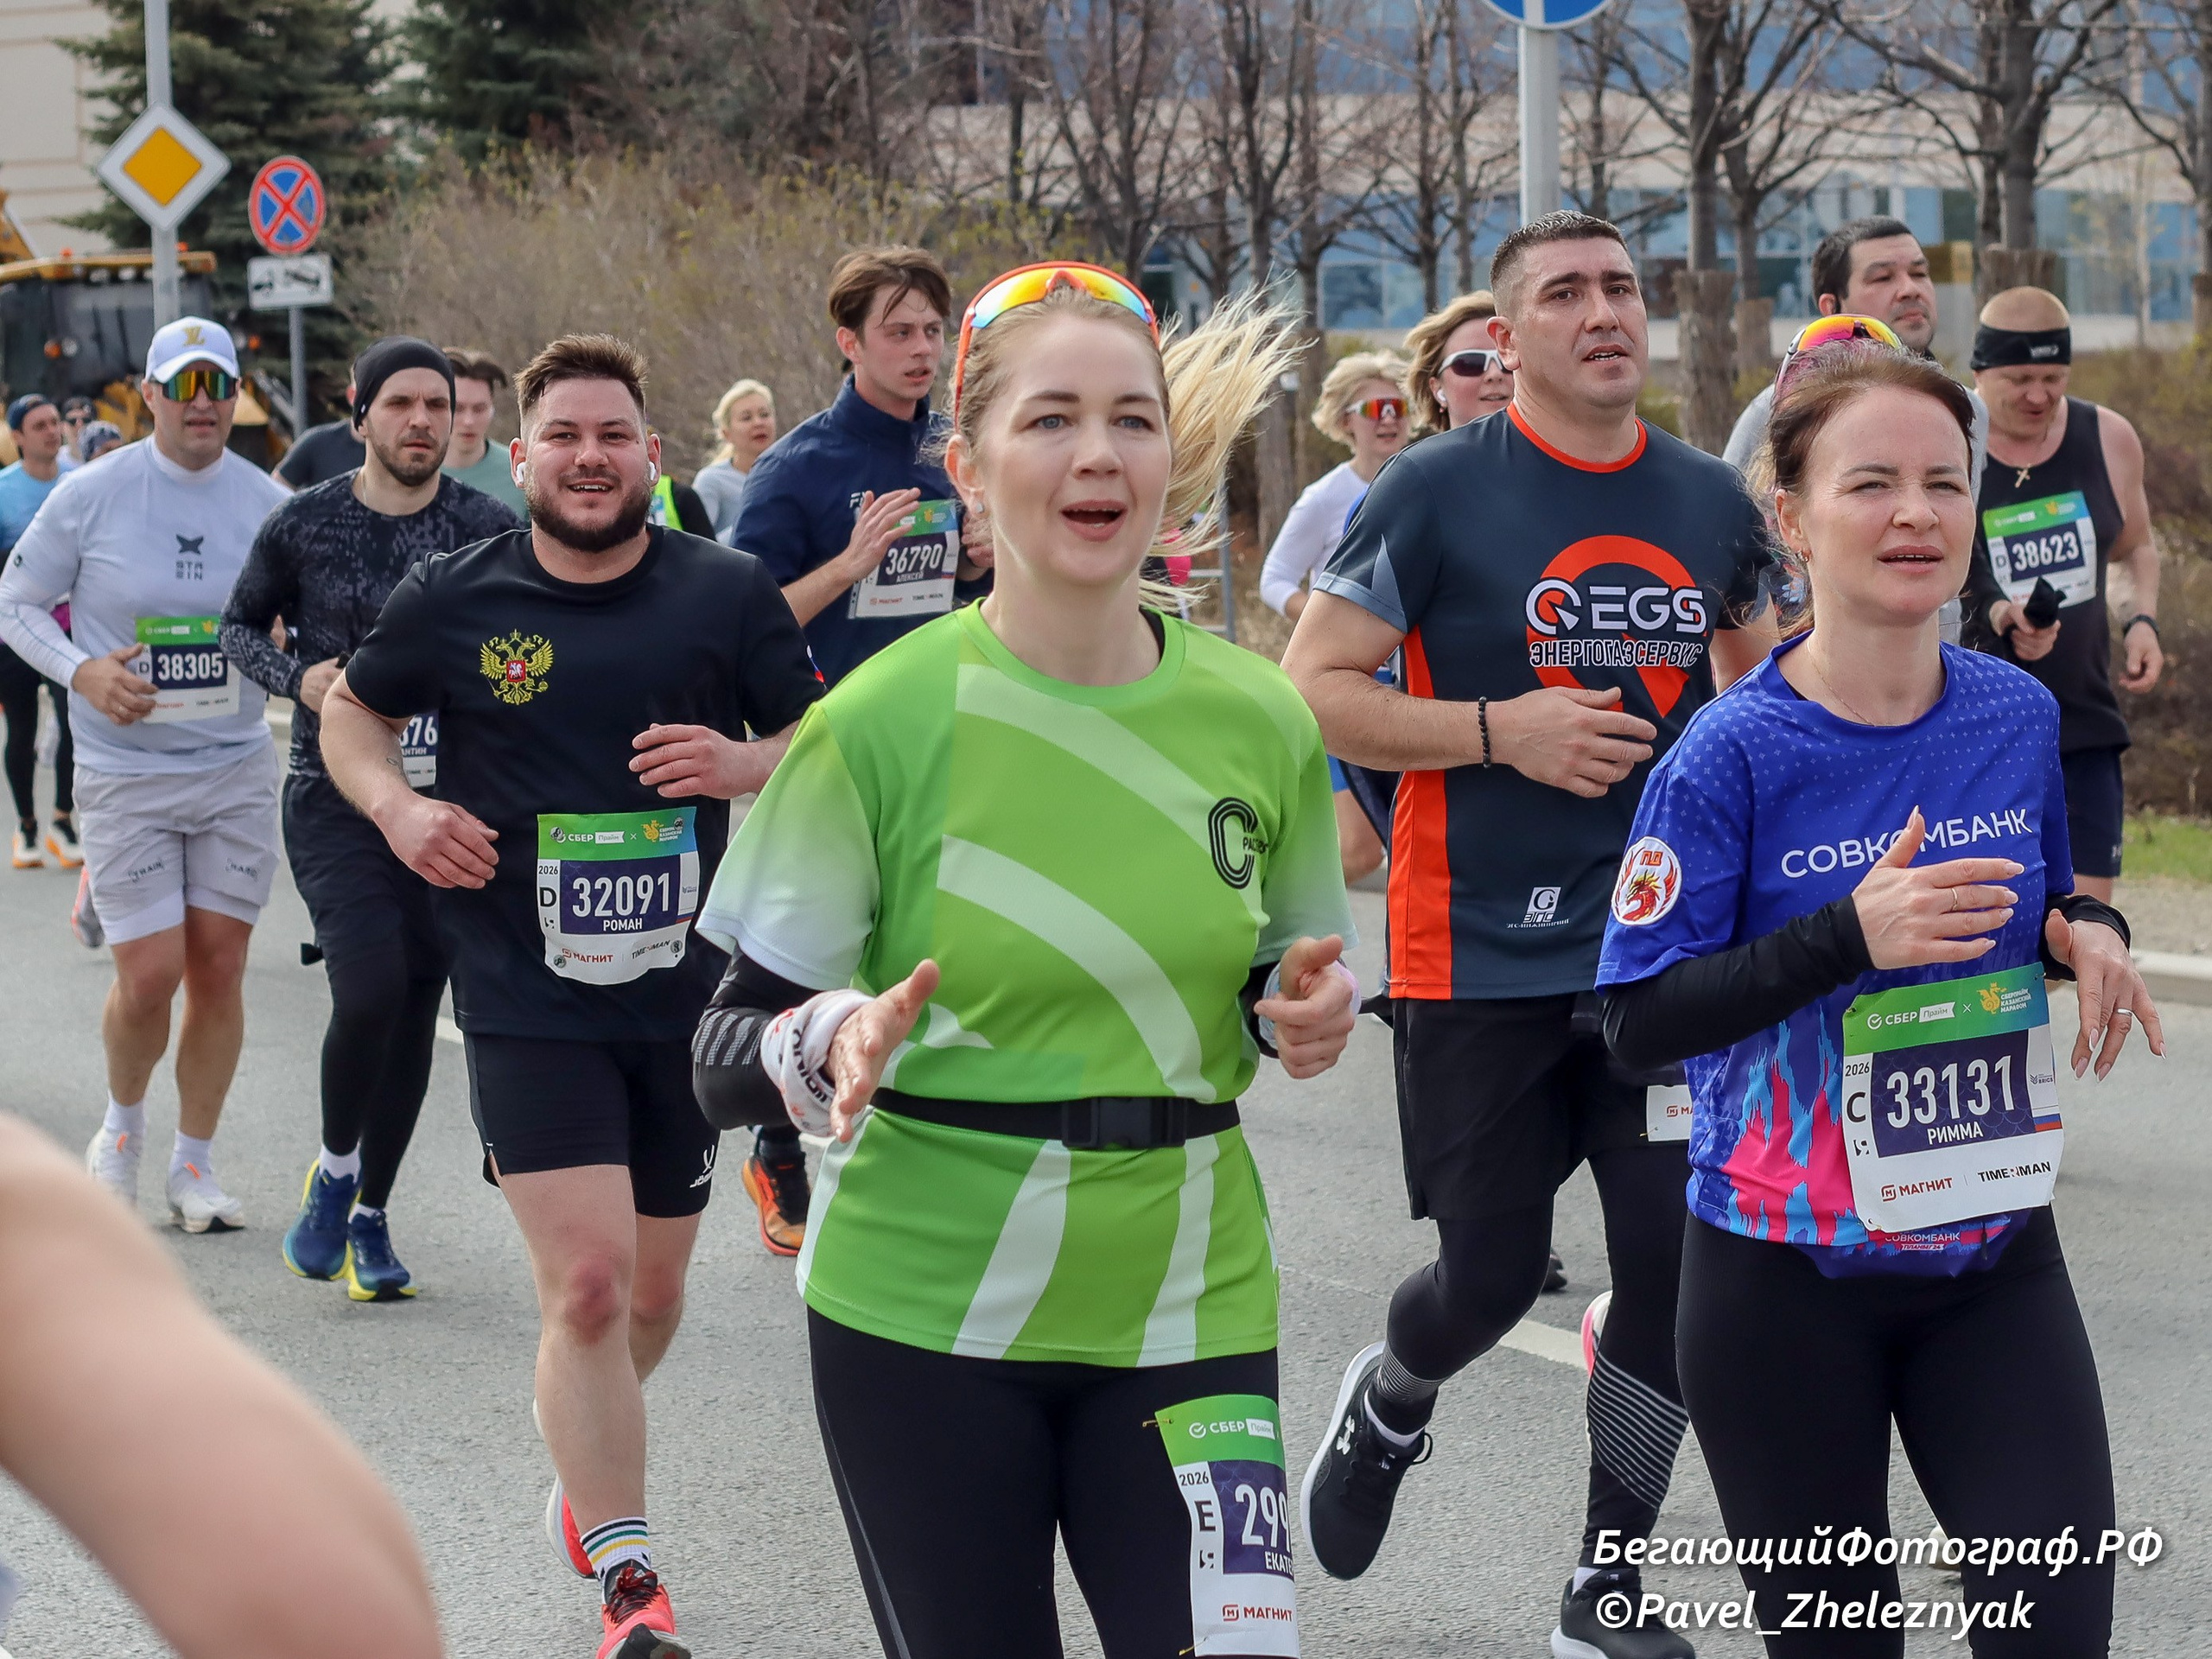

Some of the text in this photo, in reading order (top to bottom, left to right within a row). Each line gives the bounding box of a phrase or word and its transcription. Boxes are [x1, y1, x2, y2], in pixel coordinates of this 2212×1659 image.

[886, 543, 944, 575] 36790
[2012, 531, 2079, 571] 38623
[1590, 586, 1707, 634] EGS
[1529, 639, 1704, 668] ЭНЕРГОГАЗСЕРВИС
[157, 652, 224, 682] 38305
[568, 833, 594, 843] СБЕР
[1781, 808, 2032, 879] СОВКМБАНК
[538, 866, 558, 875] 2026
[539, 887, 557, 907] D
[572, 873, 670, 918] 32091
[603, 918, 643, 931] РОМАН
[574, 952, 613, 963] МАГНИТ
[1885, 1006, 1948, 1026] СБЕР Прайм
[1845, 1062, 1870, 1077] 2026
[1886, 1055, 2015, 1128] 33131
[1927, 1122, 1984, 1146] РИММА
[1899, 1177, 1953, 1197] МАГНИТ
[1209, 1421, 1244, 1433] СБЕР
[1179, 1471, 1210, 1486] 2026
[1243, 1606, 1293, 1622] МАГНИТ
